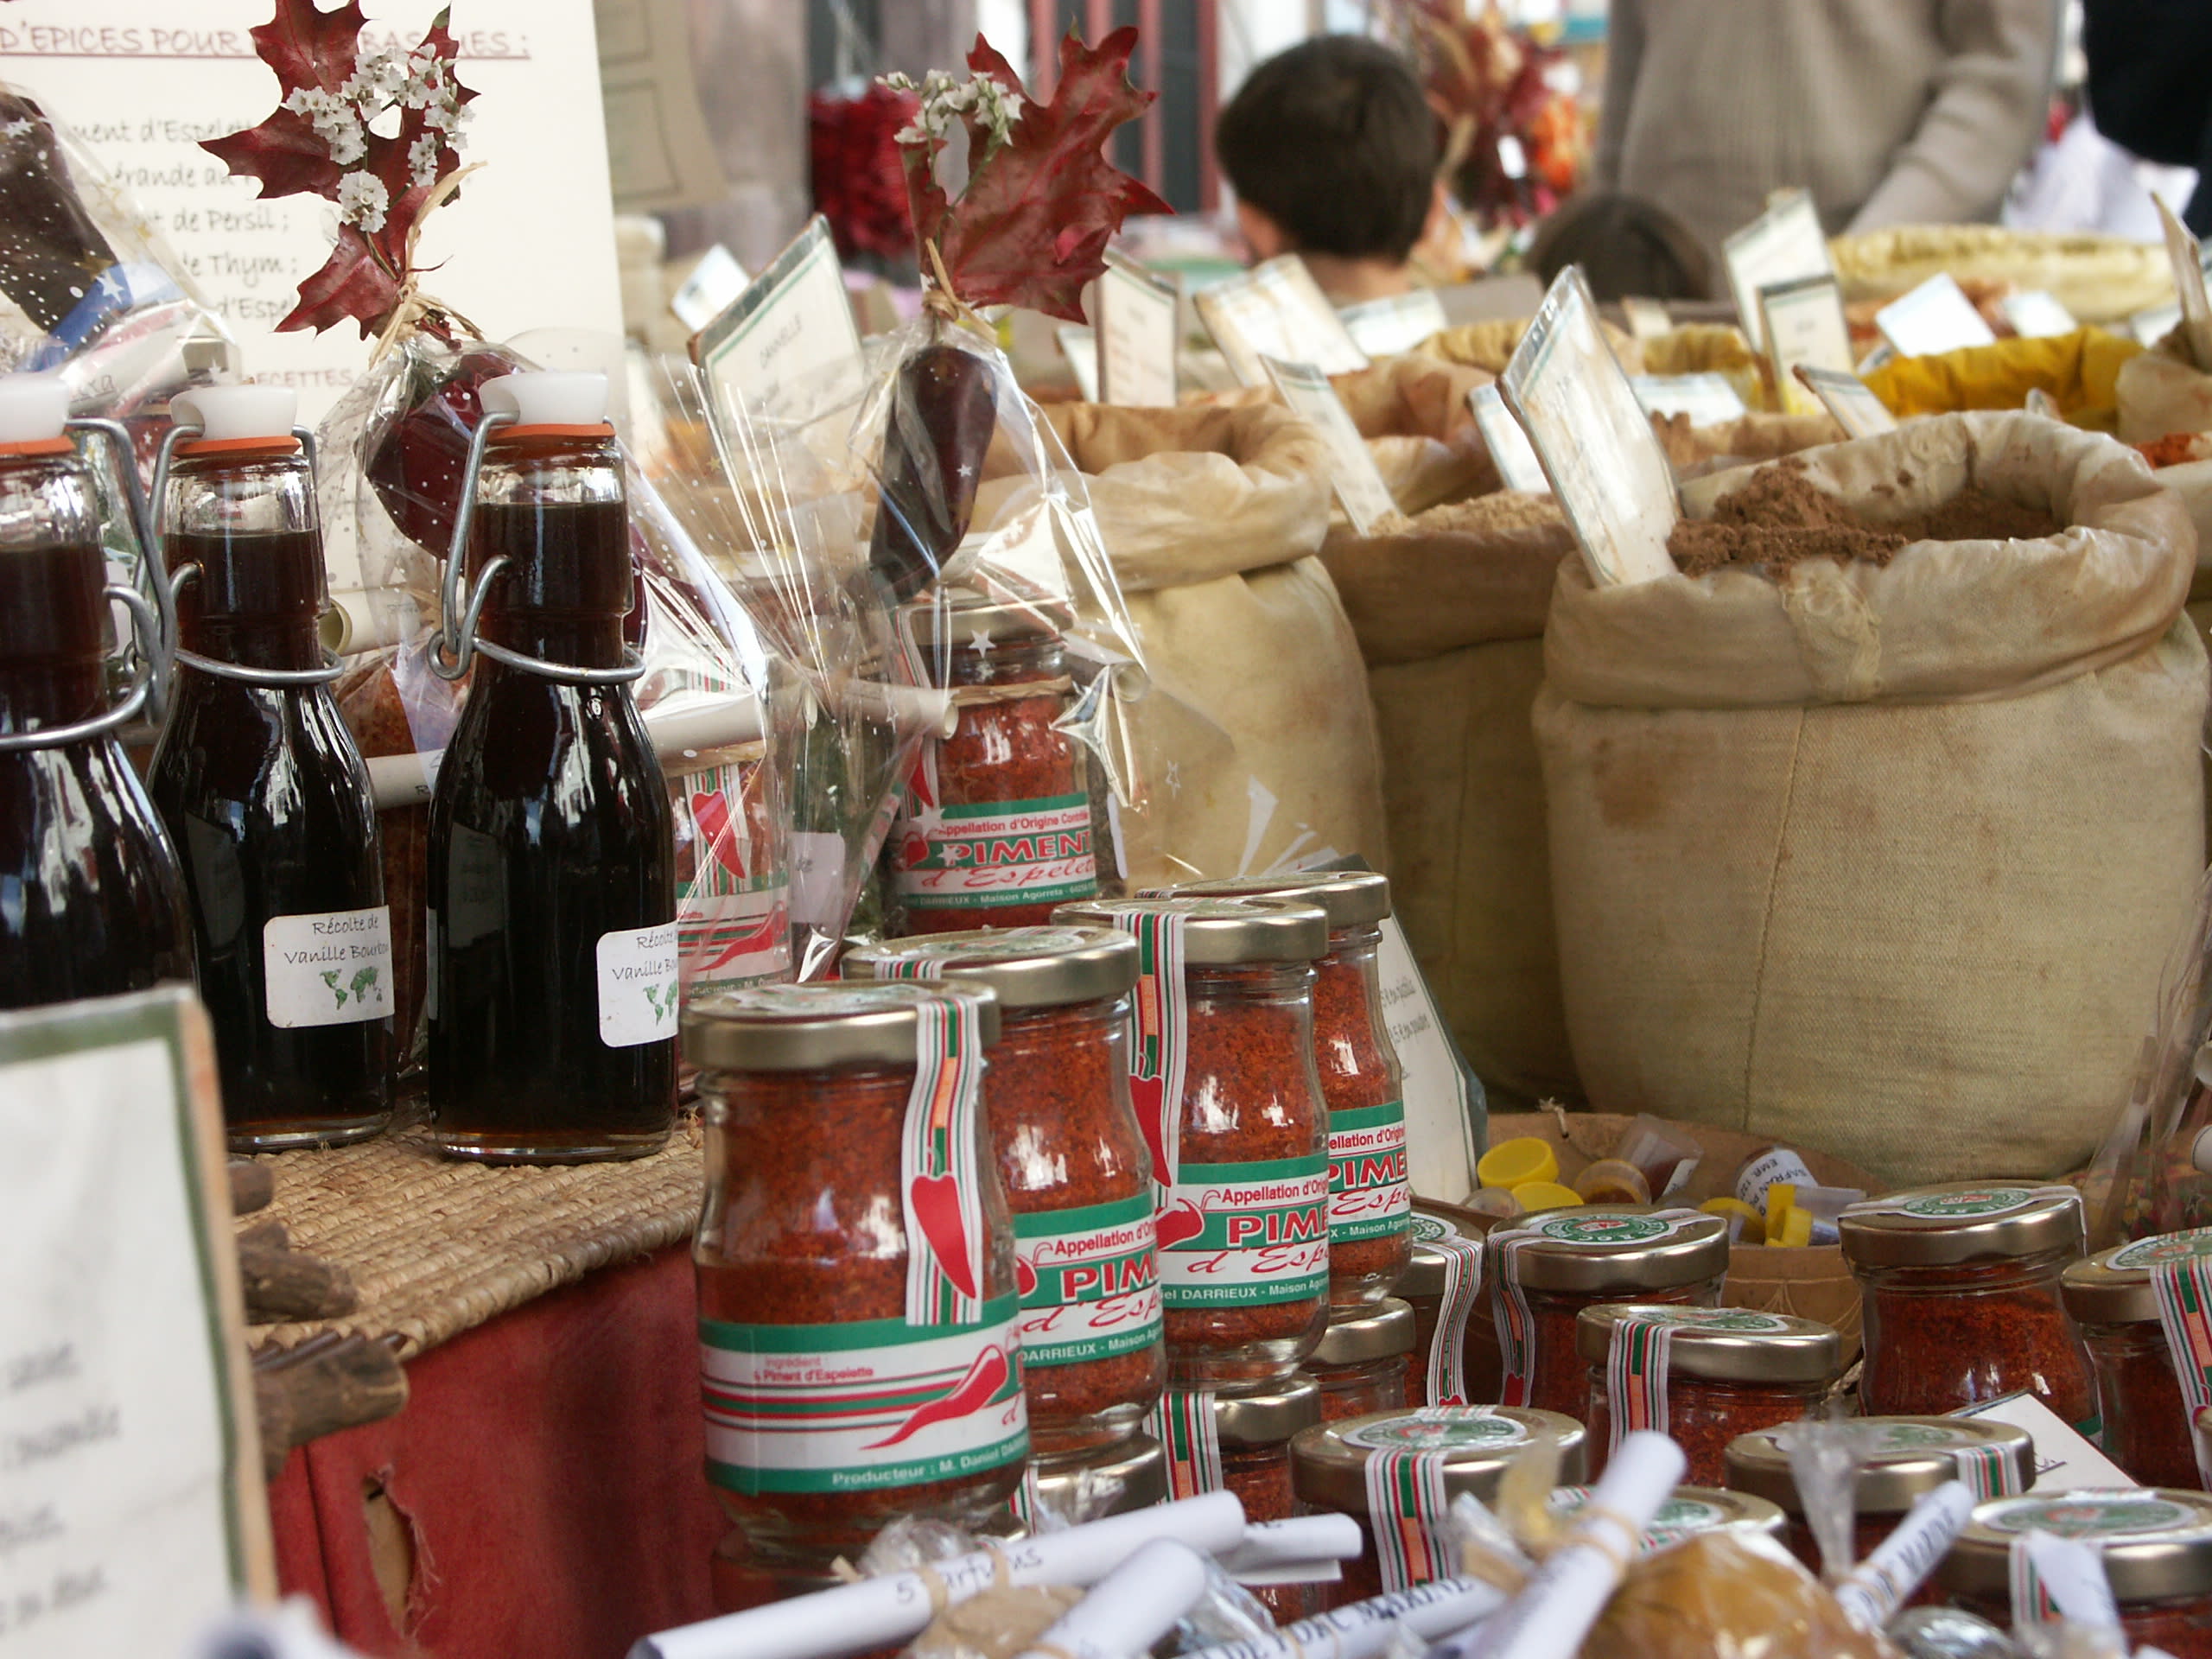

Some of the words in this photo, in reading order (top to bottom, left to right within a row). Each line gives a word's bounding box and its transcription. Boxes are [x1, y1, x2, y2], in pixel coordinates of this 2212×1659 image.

[150, 28, 243, 54] POUR
[173, 209, 200, 232] de
[207, 208, 274, 232] Persil
[210, 256, 281, 287] Thym
[258, 368, 353, 387] ECETTES
[980, 893, 1019, 904] Maison
[1023, 888, 1064, 901] Agorreta
[313, 917, 365, 935] Récolte
[1329, 1134, 1373, 1150] ellation
[1329, 1153, 1408, 1188] PIME
[1222, 1185, 1300, 1205] Appellation
[1350, 1224, 1385, 1236] Maison
[1055, 1230, 1135, 1257] Appellation
[1062, 1252, 1158, 1302] PIM
[1181, 1287, 1257, 1300] DARRIEUX
[1269, 1282, 1307, 1296] Maison
[1108, 1332, 1146, 1351] Maison
[763, 1369, 802, 1382] Piment
[832, 1466, 925, 1485] Producteur
[960, 1451, 999, 1468] Daniel
